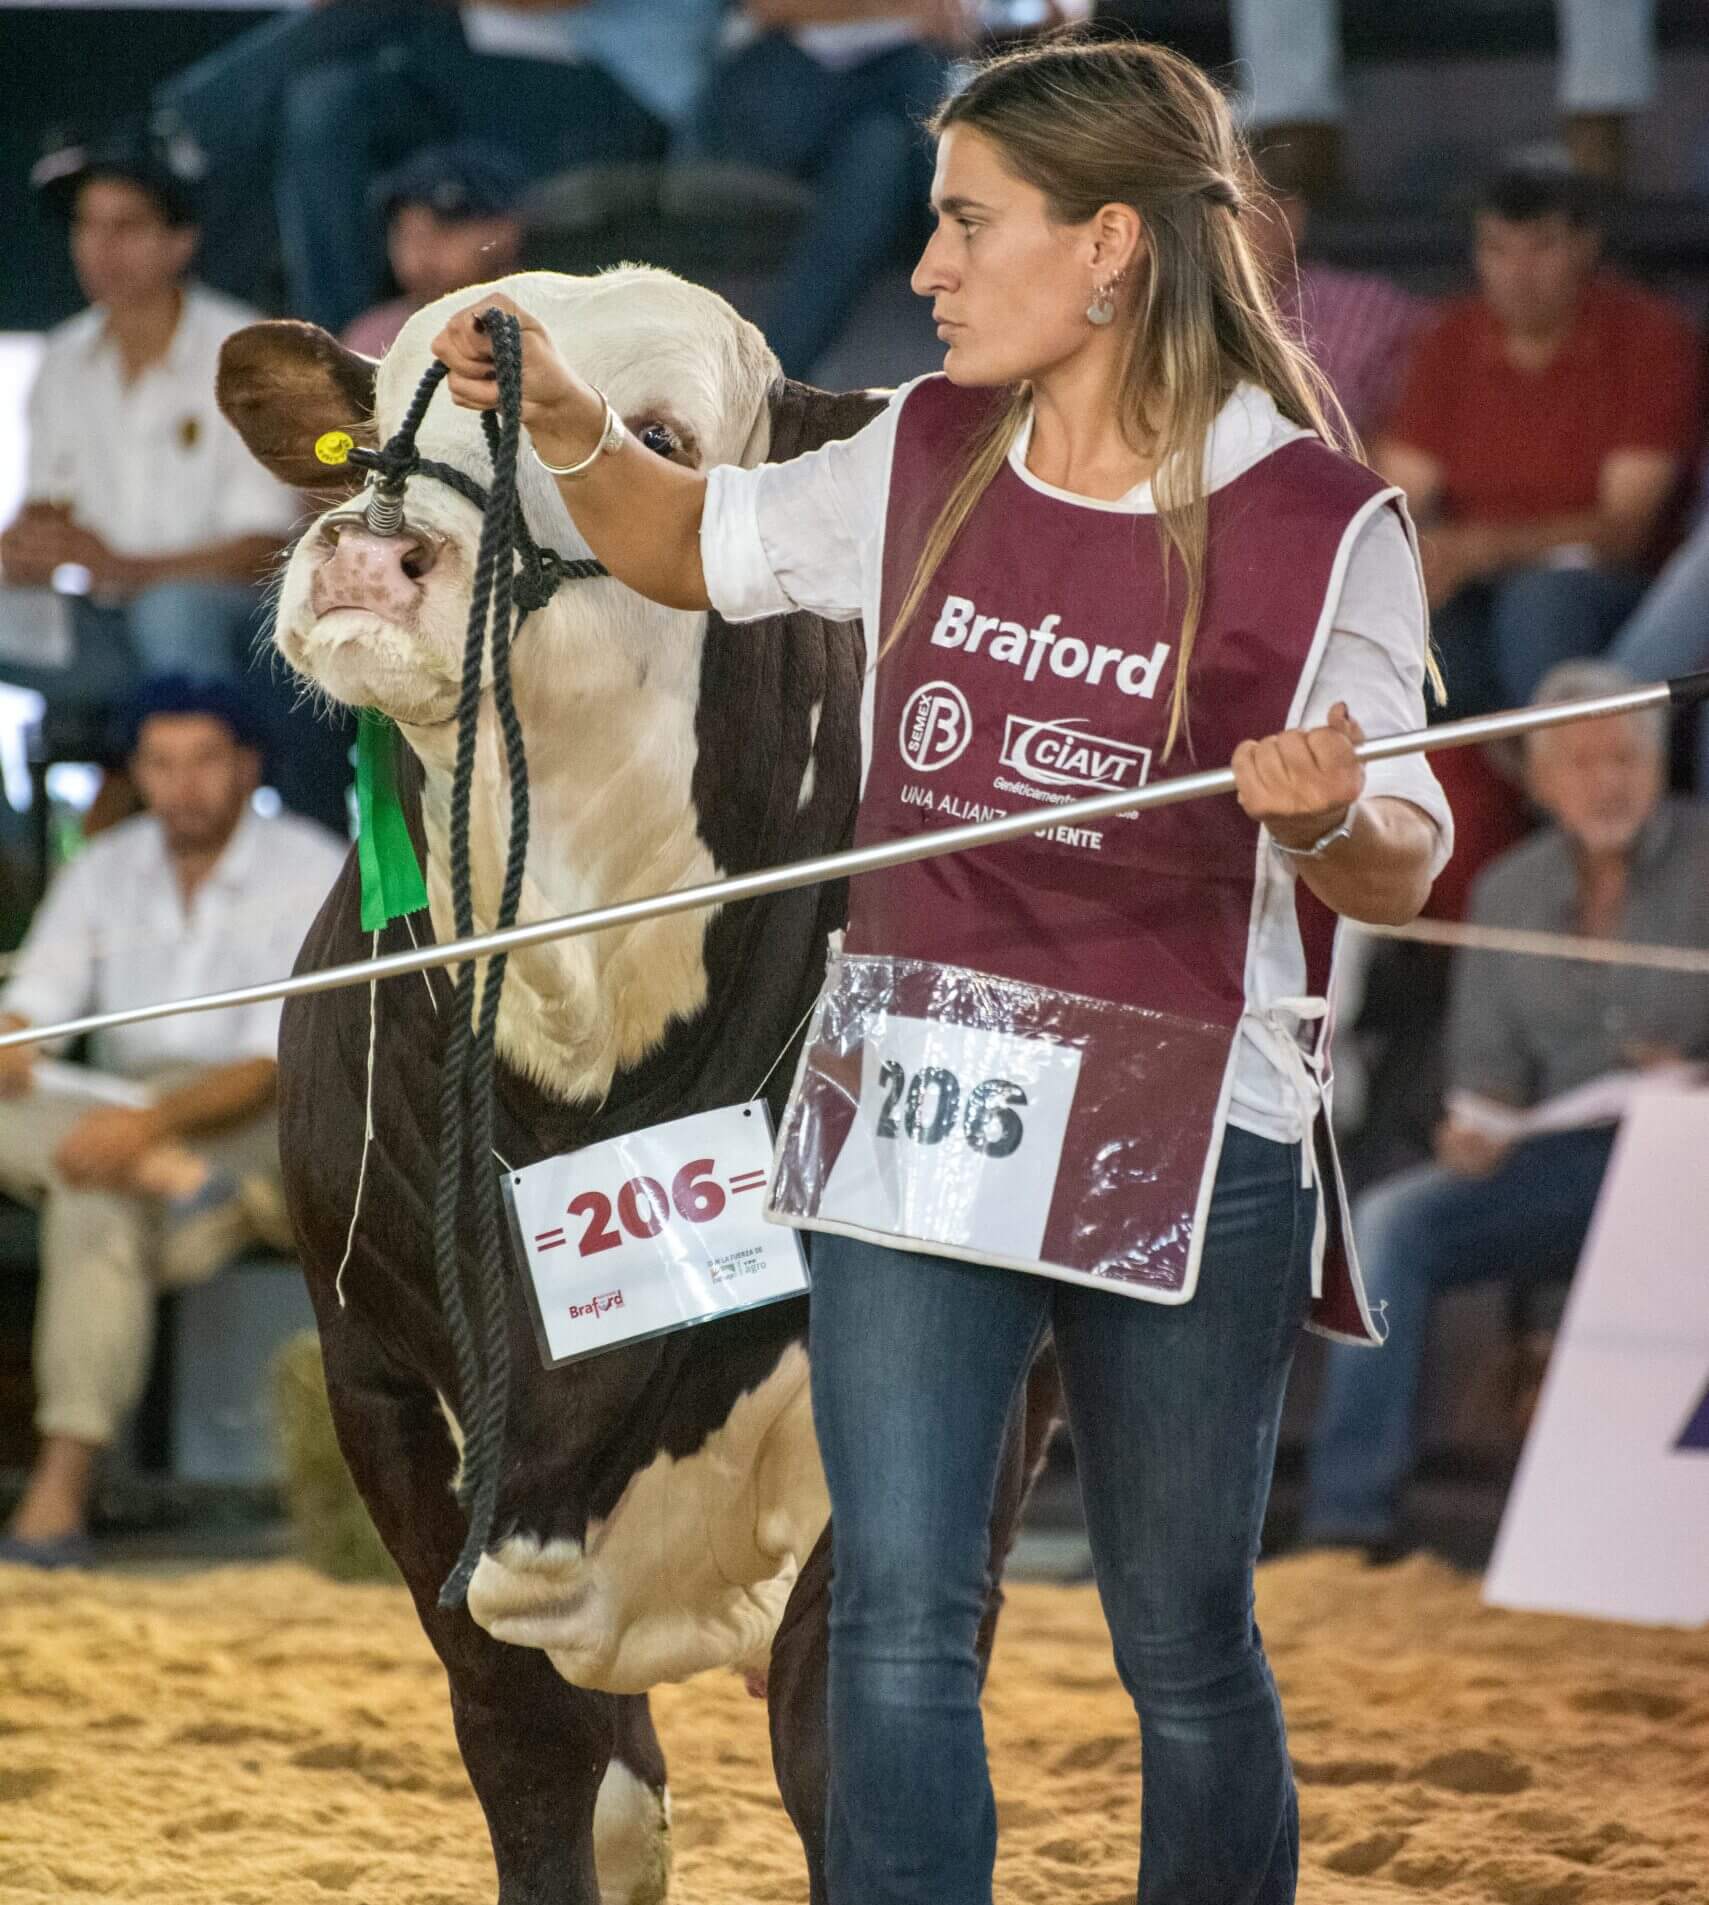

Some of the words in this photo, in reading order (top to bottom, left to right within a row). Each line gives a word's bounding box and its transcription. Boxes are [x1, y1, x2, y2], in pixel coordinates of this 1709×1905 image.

[930, 595, 1171, 699] Braford
[907, 693, 934, 752] SEMEX
[901, 784, 934, 809] UNA
[876, 1060, 1028, 1159] 206
